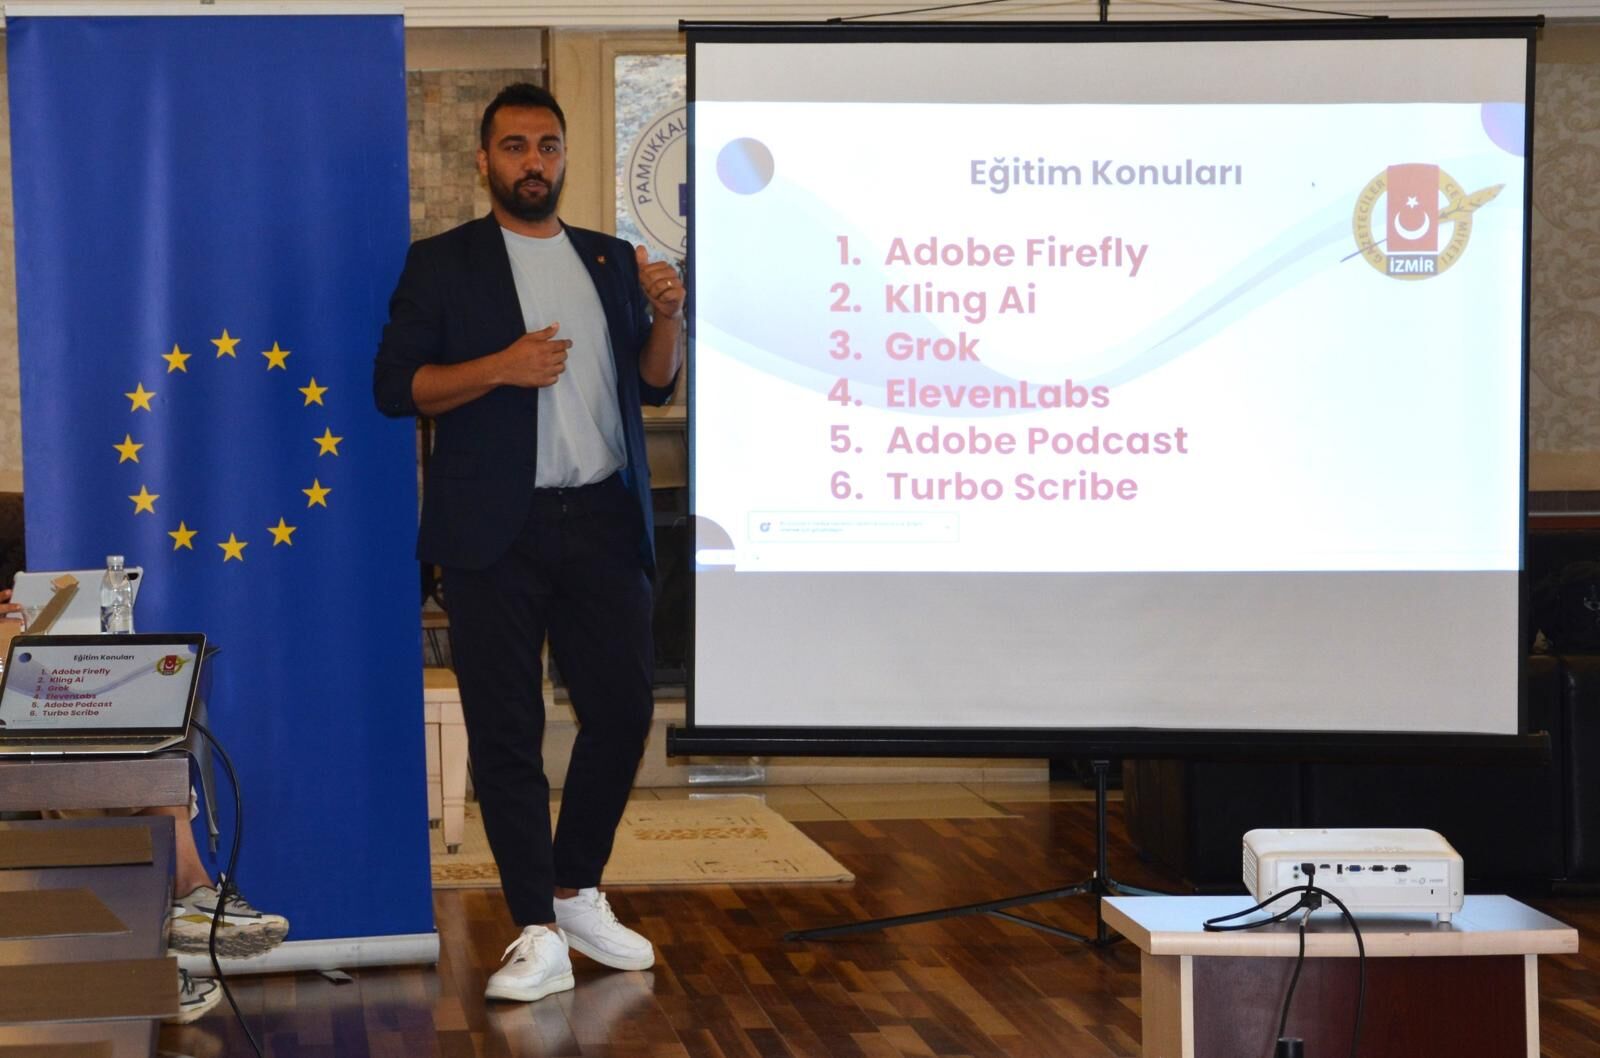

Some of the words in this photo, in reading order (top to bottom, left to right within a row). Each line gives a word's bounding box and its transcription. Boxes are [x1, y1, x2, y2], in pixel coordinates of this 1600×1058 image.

[970, 156, 1082, 195] Eğitim
[1092, 158, 1242, 186] Konuları
[836, 235, 862, 266] 1.
[884, 236, 1016, 267] Adobe
[1026, 235, 1149, 278] Firefly
[1389, 256, 1435, 273] İZMİR
[829, 282, 862, 313] 2.
[885, 281, 987, 325] Kling
[998, 282, 1036, 314] Ai
[829, 329, 862, 361] 3.
[885, 331, 980, 362] Grok
[827, 377, 863, 407] 4.
[886, 377, 1110, 409] ElevenLabs
[830, 424, 863, 454] 5.
[886, 425, 1017, 455] Adobe
[1028, 425, 1188, 455] Podcast
[830, 470, 864, 500] 6.
[886, 471, 1004, 501] Turbo
[1014, 469, 1138, 501] Scribe
[73, 654, 99, 662] Eğitim
[82, 668, 111, 676] Firefly
[49, 676, 73, 684] Kling
